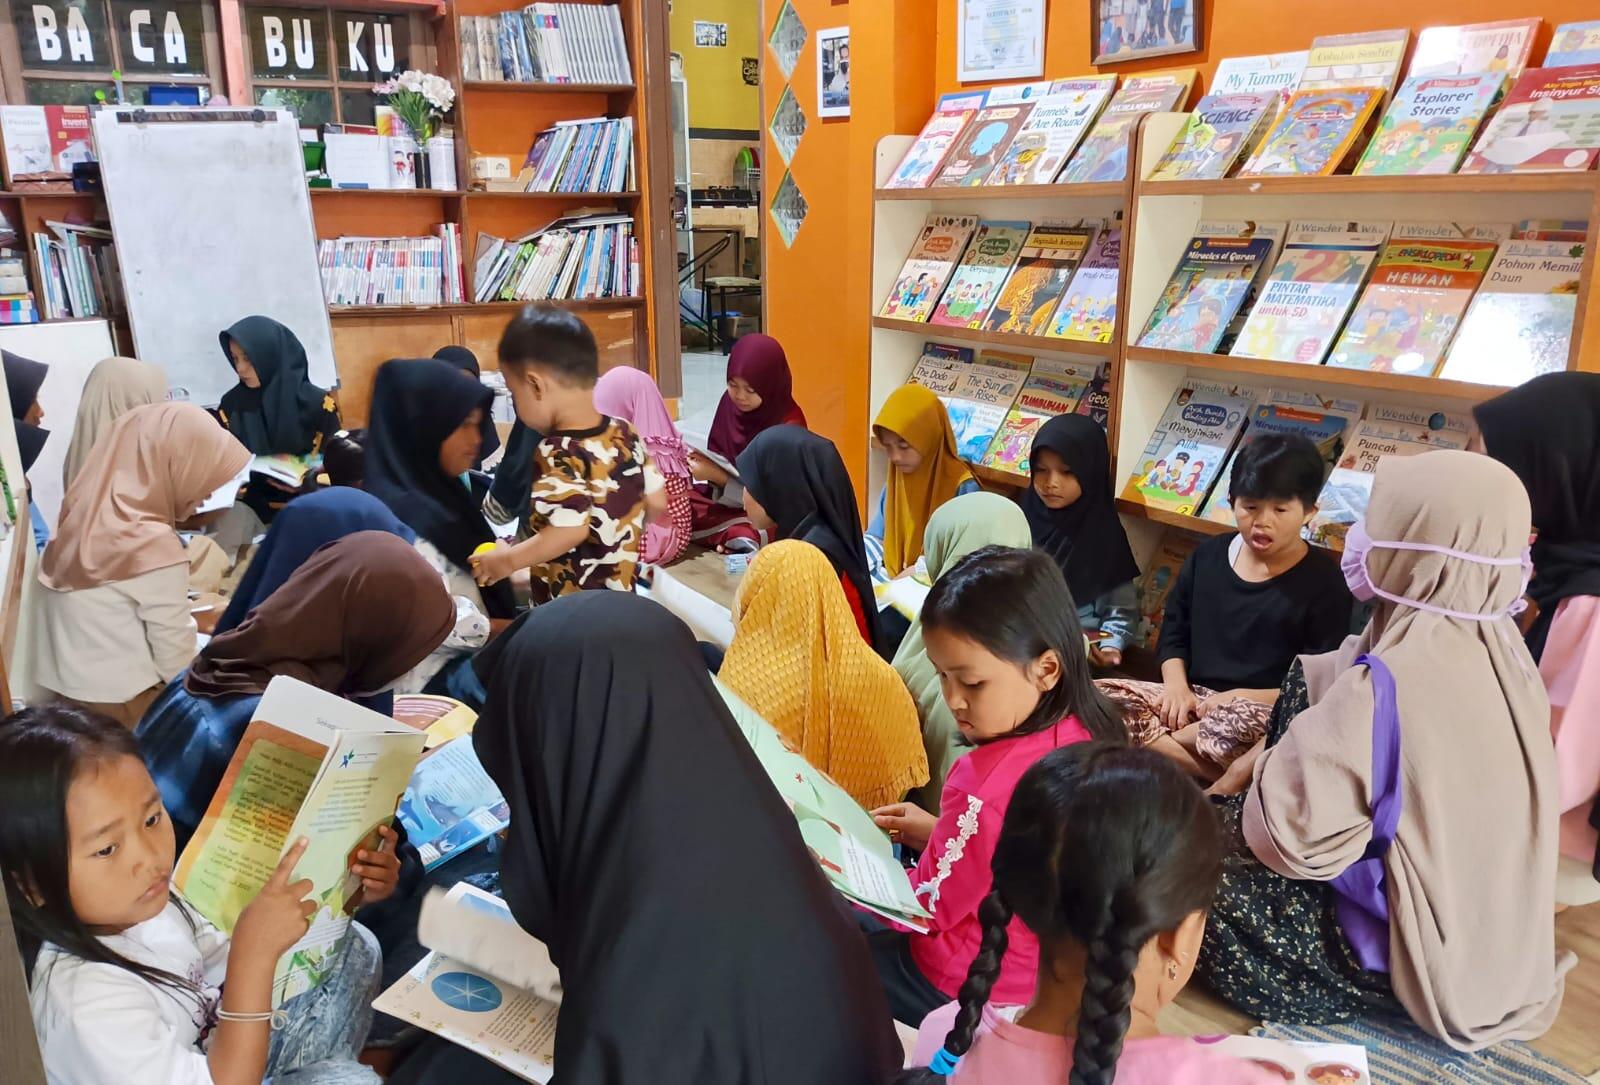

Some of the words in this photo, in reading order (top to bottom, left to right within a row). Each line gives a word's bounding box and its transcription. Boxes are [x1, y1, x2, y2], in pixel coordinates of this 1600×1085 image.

[33, 5, 95, 63] BA
[129, 9, 187, 64] CA
[263, 16, 315, 69] BU
[347, 21, 395, 72] KU
[1225, 73, 1244, 87] My
[1248, 72, 1297, 86] Tummy
[1414, 93, 1473, 105] Explorer
[1529, 88, 1586, 99] Insinyur
[1033, 105, 1070, 118] Tunnels
[1410, 106, 1461, 116] Stories
[1031, 119, 1050, 129] Are
[1051, 115, 1087, 129] Round
[1193, 108, 1257, 128] SCIENCE
[1301, 224, 1343, 233] Wonder
[1407, 224, 1453, 236] Wonder
[1187, 250, 1221, 261] Miracles
[1229, 252, 1256, 262] Quran
[1497, 258, 1536, 271] Pohon
[1539, 260, 1584, 273] Memili
[1386, 271, 1454, 287] HEWAN
[1490, 271, 1522, 284] Daun
[1270, 282, 1311, 294] PINTAR
[1264, 293, 1337, 308] MATEMATIKA
[1257, 305, 1288, 317] untuk
[1291, 306, 1308, 318] SD
[916, 366, 929, 377] The
[929, 369, 948, 381] Dodo
[929, 381, 948, 393] Dead
[967, 374, 982, 387] The
[983, 377, 1001, 391] Sun
[974, 388, 999, 403] Rises
[1382, 408, 1426, 423] Wonder
[1168, 420, 1224, 440] Mengimani
[1175, 438, 1199, 451] Allah
[1358, 438, 1398, 454] Puncak
[1360, 450, 1380, 463] Peg
